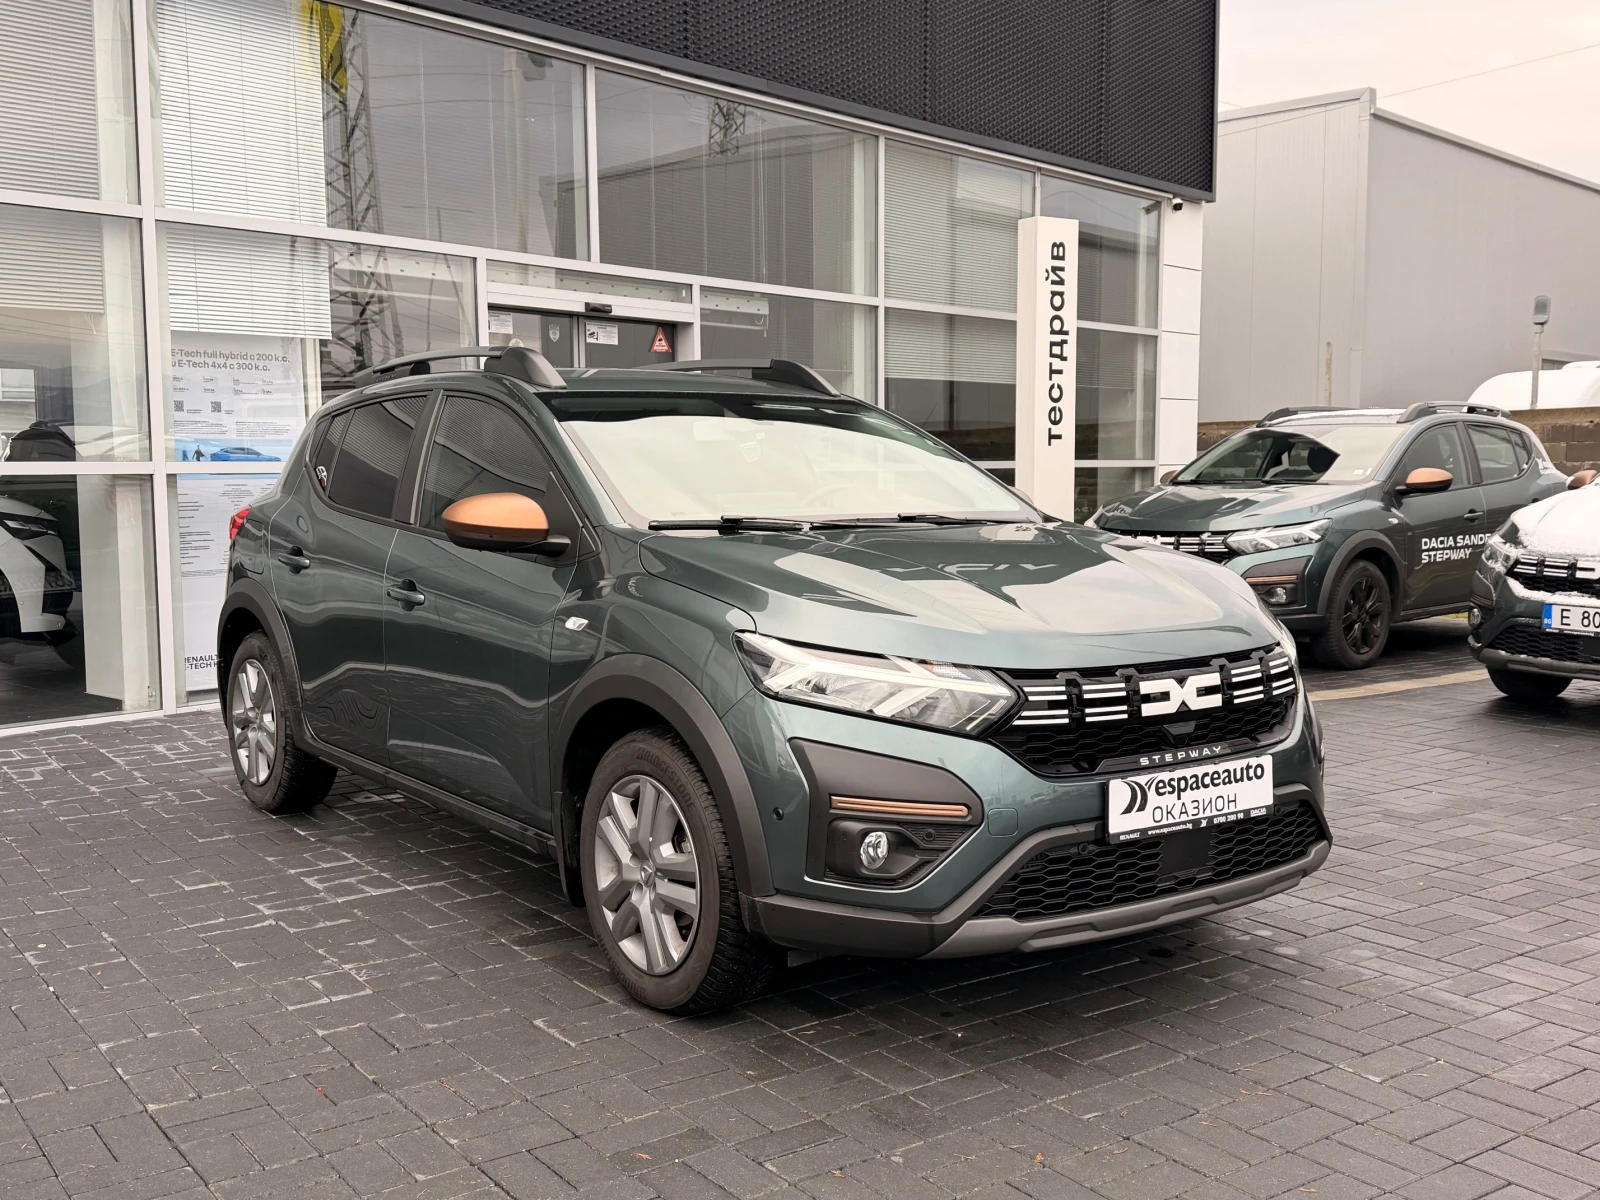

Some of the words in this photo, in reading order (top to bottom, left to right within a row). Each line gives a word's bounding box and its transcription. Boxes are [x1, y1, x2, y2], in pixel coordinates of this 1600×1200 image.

[1044, 241, 1070, 446] тестдрайв
[171, 348, 202, 359] E-Tech
[203, 349, 219, 359] full
[219, 350, 248, 362] hybrid
[256, 353, 273, 362] 200
[178, 360, 209, 369] E-Tech
[210, 361, 228, 370] 4x4
[236, 362, 253, 371] 300
[1421, 536, 1455, 550] DACIA
[1421, 547, 1473, 564] STEPWAY
[1560, 608, 1571, 626] E
[184, 654, 218, 664] ENAULT
[1139, 745, 1222, 766] STEPWAY
[635, 746, 696, 811] BRIDGESTONE
[1154, 761, 1265, 800] espaceauto
[1152, 793, 1237, 823] ОКАЗИОН
[1119, 831, 1140, 841] RENAULT
[1213, 815, 1226, 825] 0700
[1227, 813, 1237, 822] 200
[1250, 807, 1267, 816] DACIA
